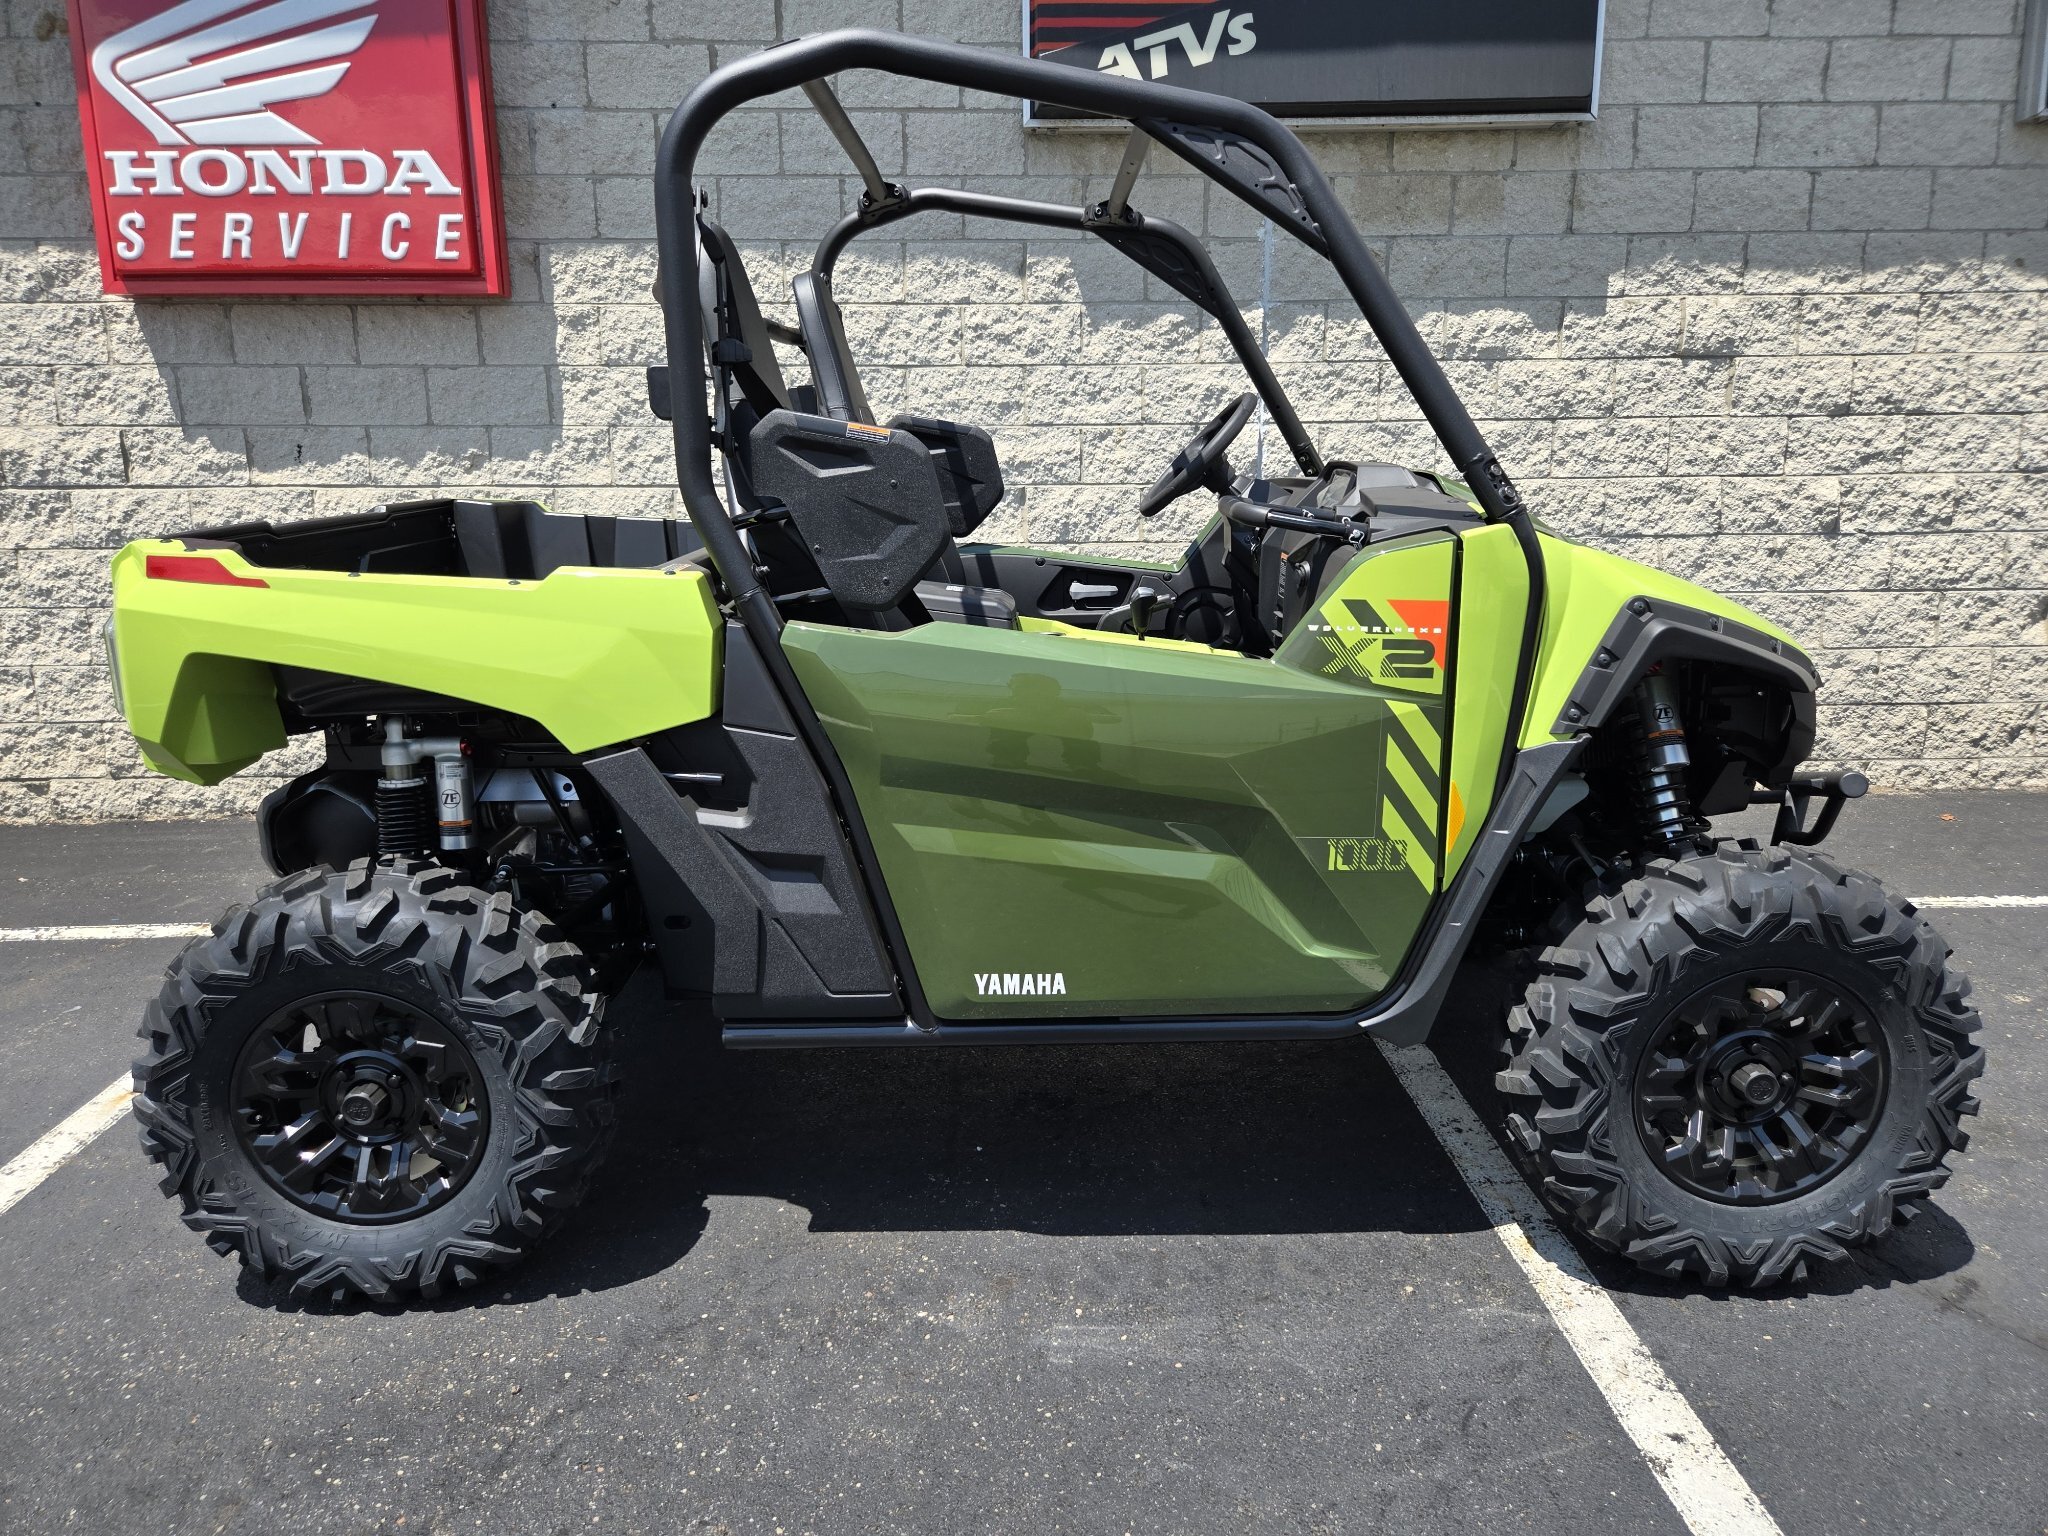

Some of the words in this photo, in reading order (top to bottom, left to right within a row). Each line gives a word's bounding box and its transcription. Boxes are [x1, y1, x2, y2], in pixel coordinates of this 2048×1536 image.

[1098, 9, 1257, 80] ATVs
[104, 148, 461, 196] HONDA
[116, 210, 463, 261] SERVICE
[1316, 637, 1436, 679] X2
[1327, 838, 1408, 871] 1000
[974, 972, 1067, 995] YAMAHA
